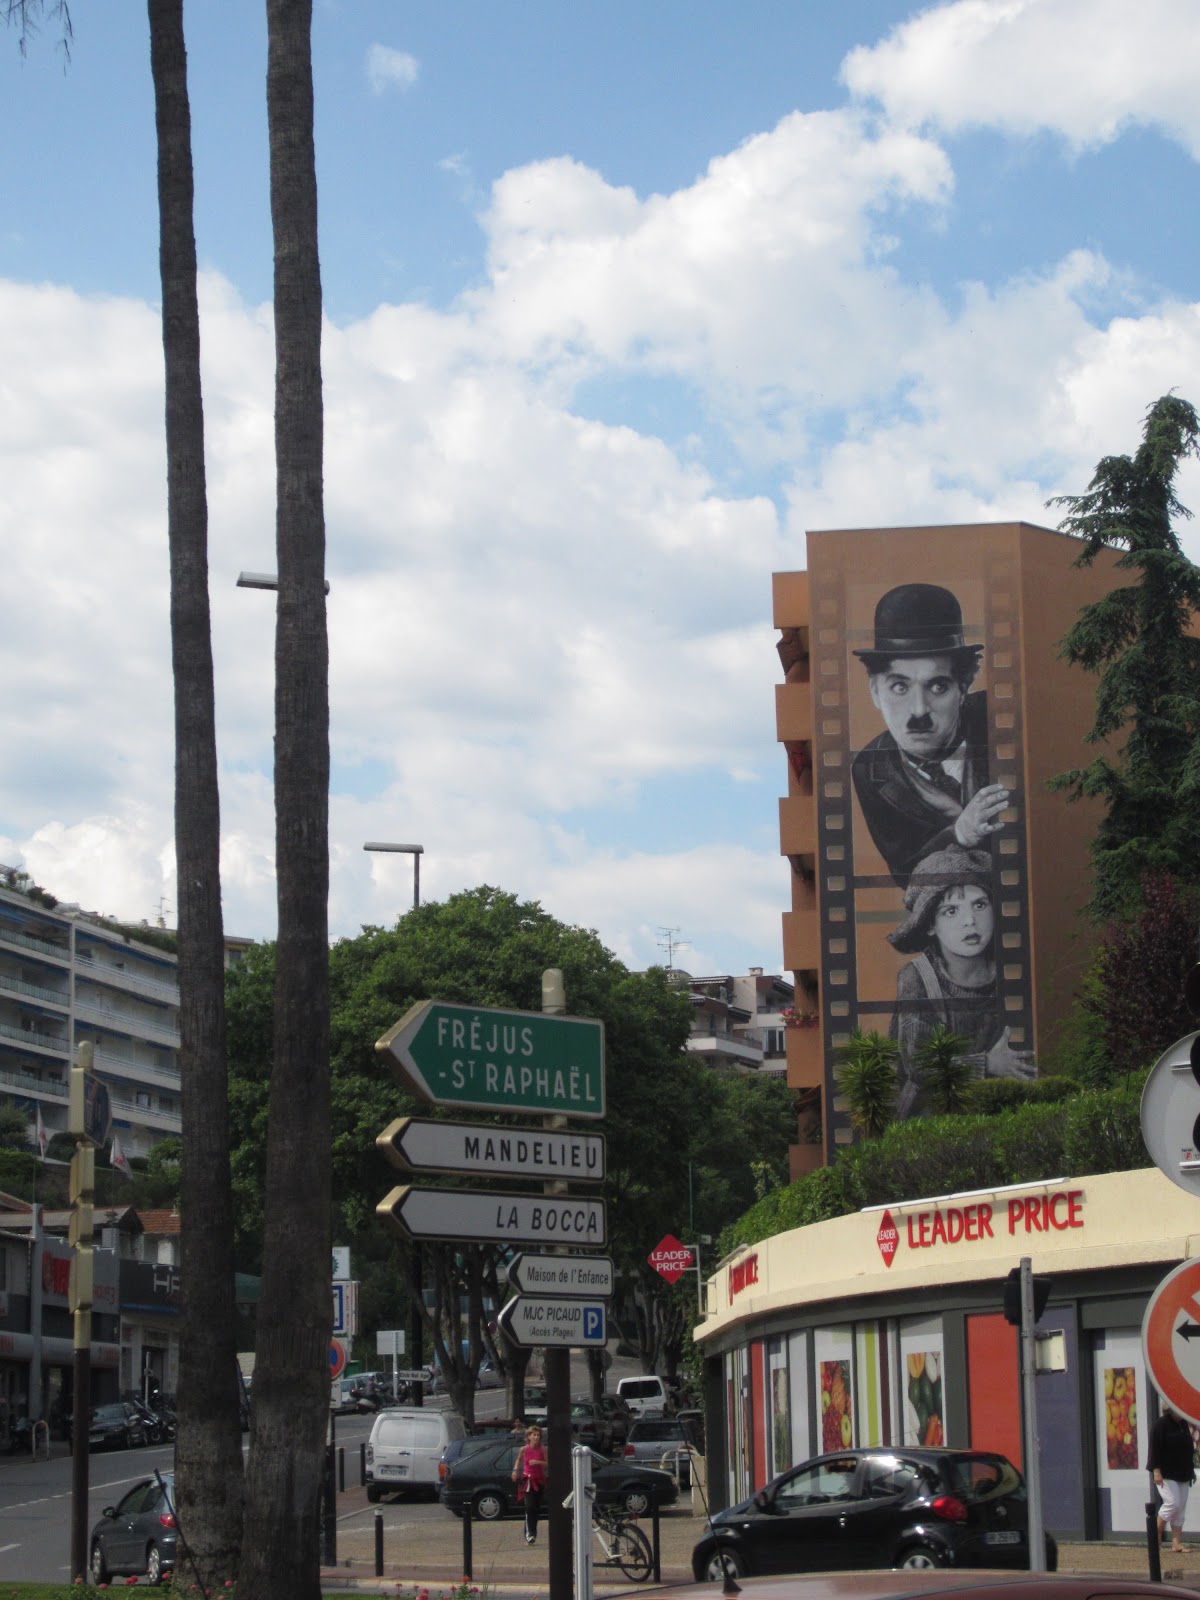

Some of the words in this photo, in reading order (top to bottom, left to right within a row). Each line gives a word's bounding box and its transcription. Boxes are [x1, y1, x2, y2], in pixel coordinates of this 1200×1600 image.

[437, 1015, 534, 1057] FRÉJUS
[485, 1062, 596, 1102] RAPHAËL
[464, 1136, 597, 1169] MANDELIEU
[496, 1205, 519, 1229] LA
[531, 1207, 597, 1234] BOCCA
[907, 1203, 995, 1248] LEADER
[1008, 1190, 1084, 1236] PRICE
[878, 1229, 896, 1241] LEADER
[880, 1241, 894, 1253] PRICE
[651, 1250, 691, 1261] LEADER
[656, 1261, 686, 1272] PRICE
[527, 1266, 556, 1281] Maison
[558, 1269, 568, 1283] de
[523, 1306, 544, 1321] MJC
[546, 1307, 581, 1322] PICAUD
[587, 1311, 599, 1336] P
